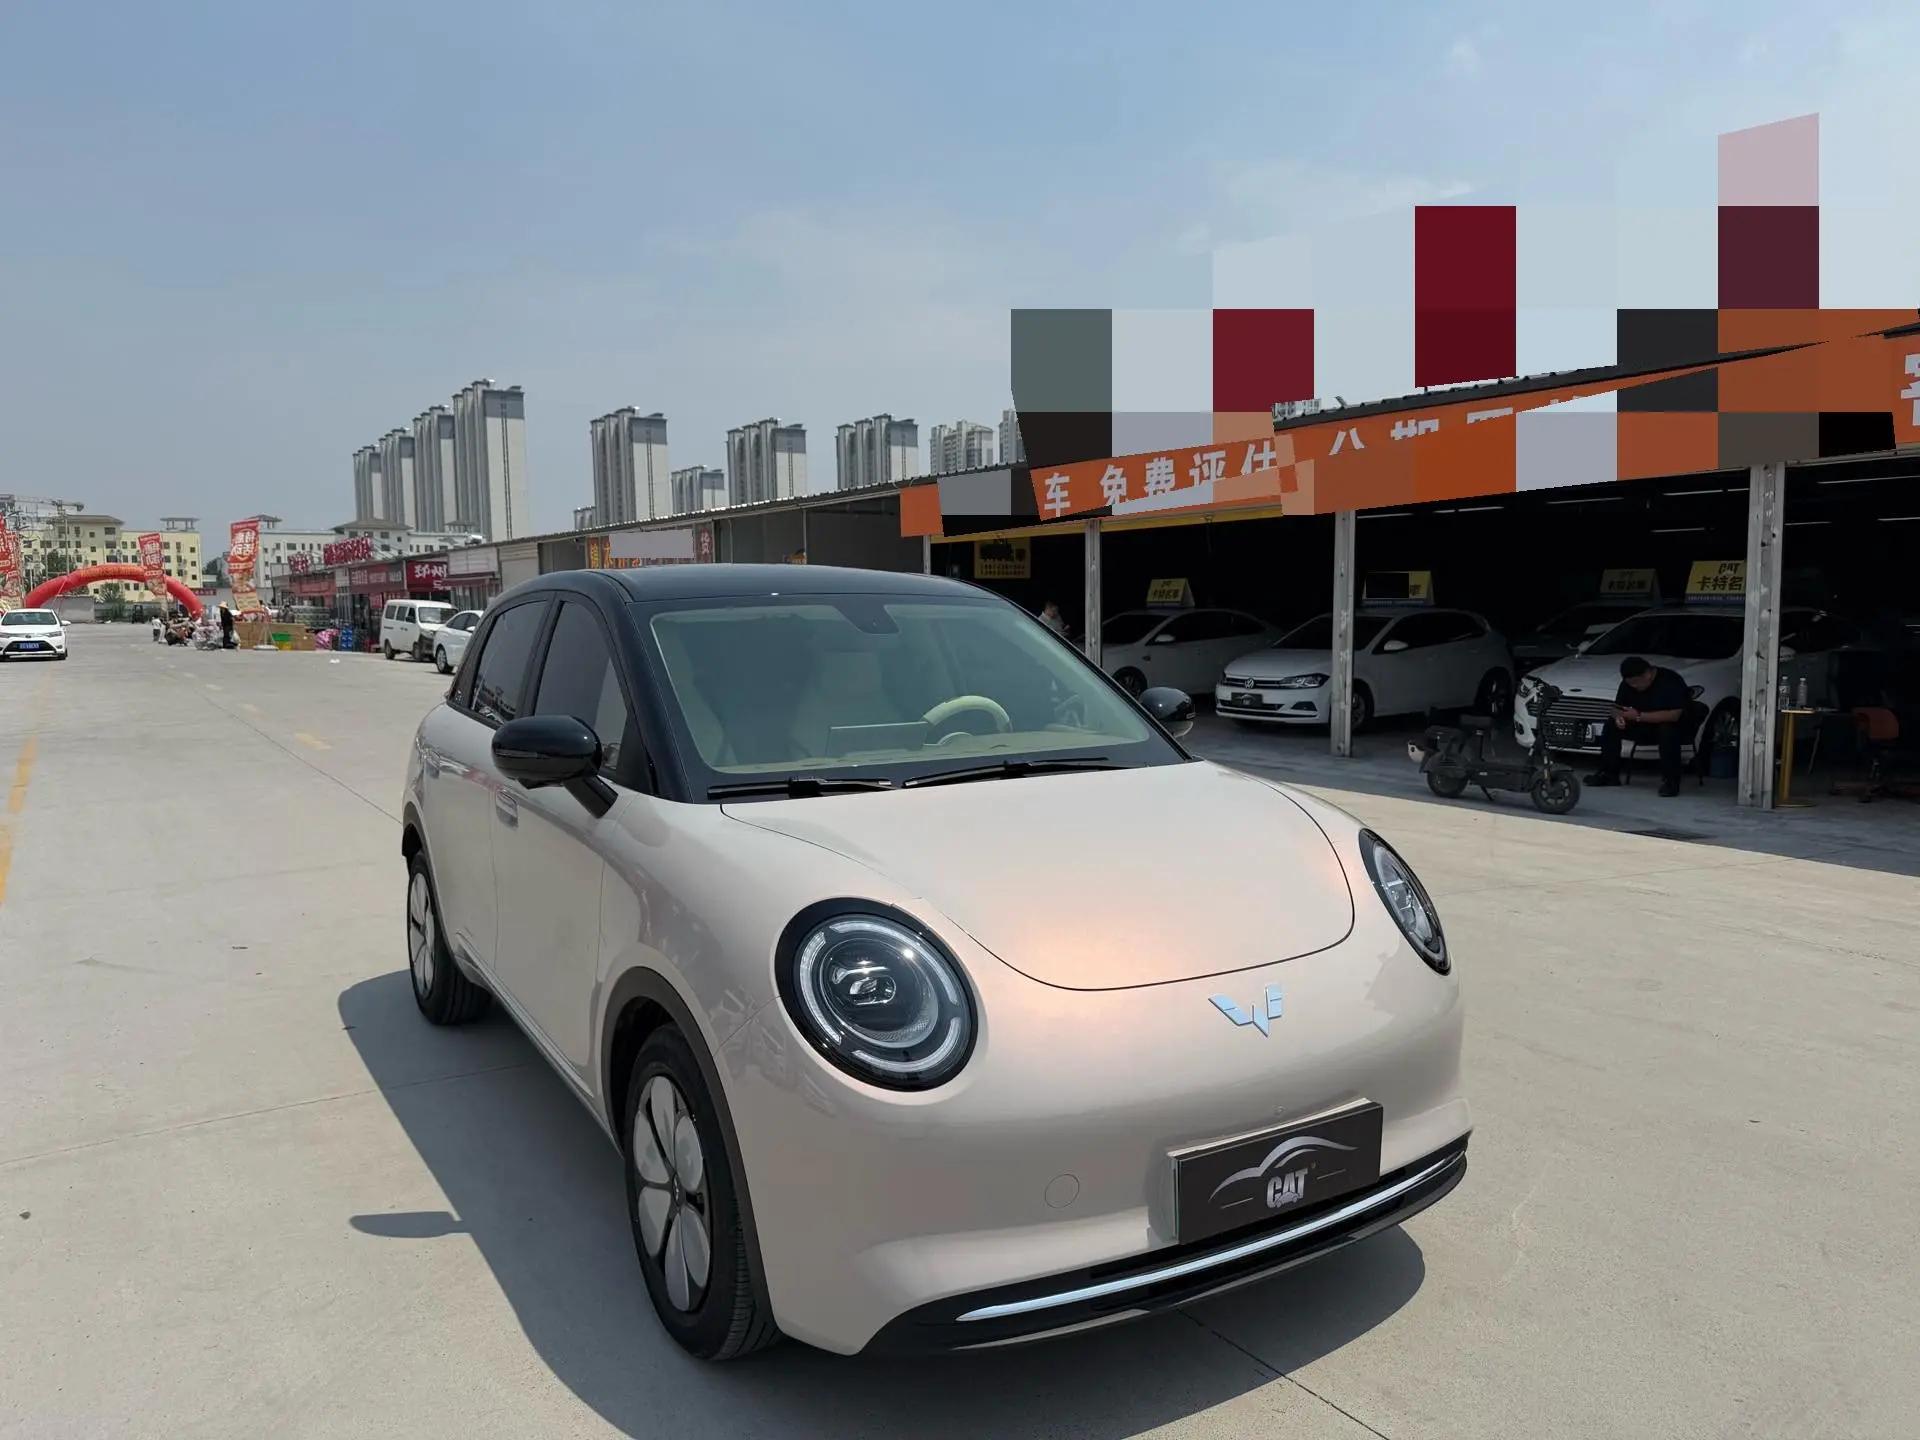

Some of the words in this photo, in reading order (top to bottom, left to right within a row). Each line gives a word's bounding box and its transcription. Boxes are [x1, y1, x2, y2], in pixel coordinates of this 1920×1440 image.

[1696, 575, 1744, 591] 卡特名
[1266, 1168, 1308, 1209] CAT
